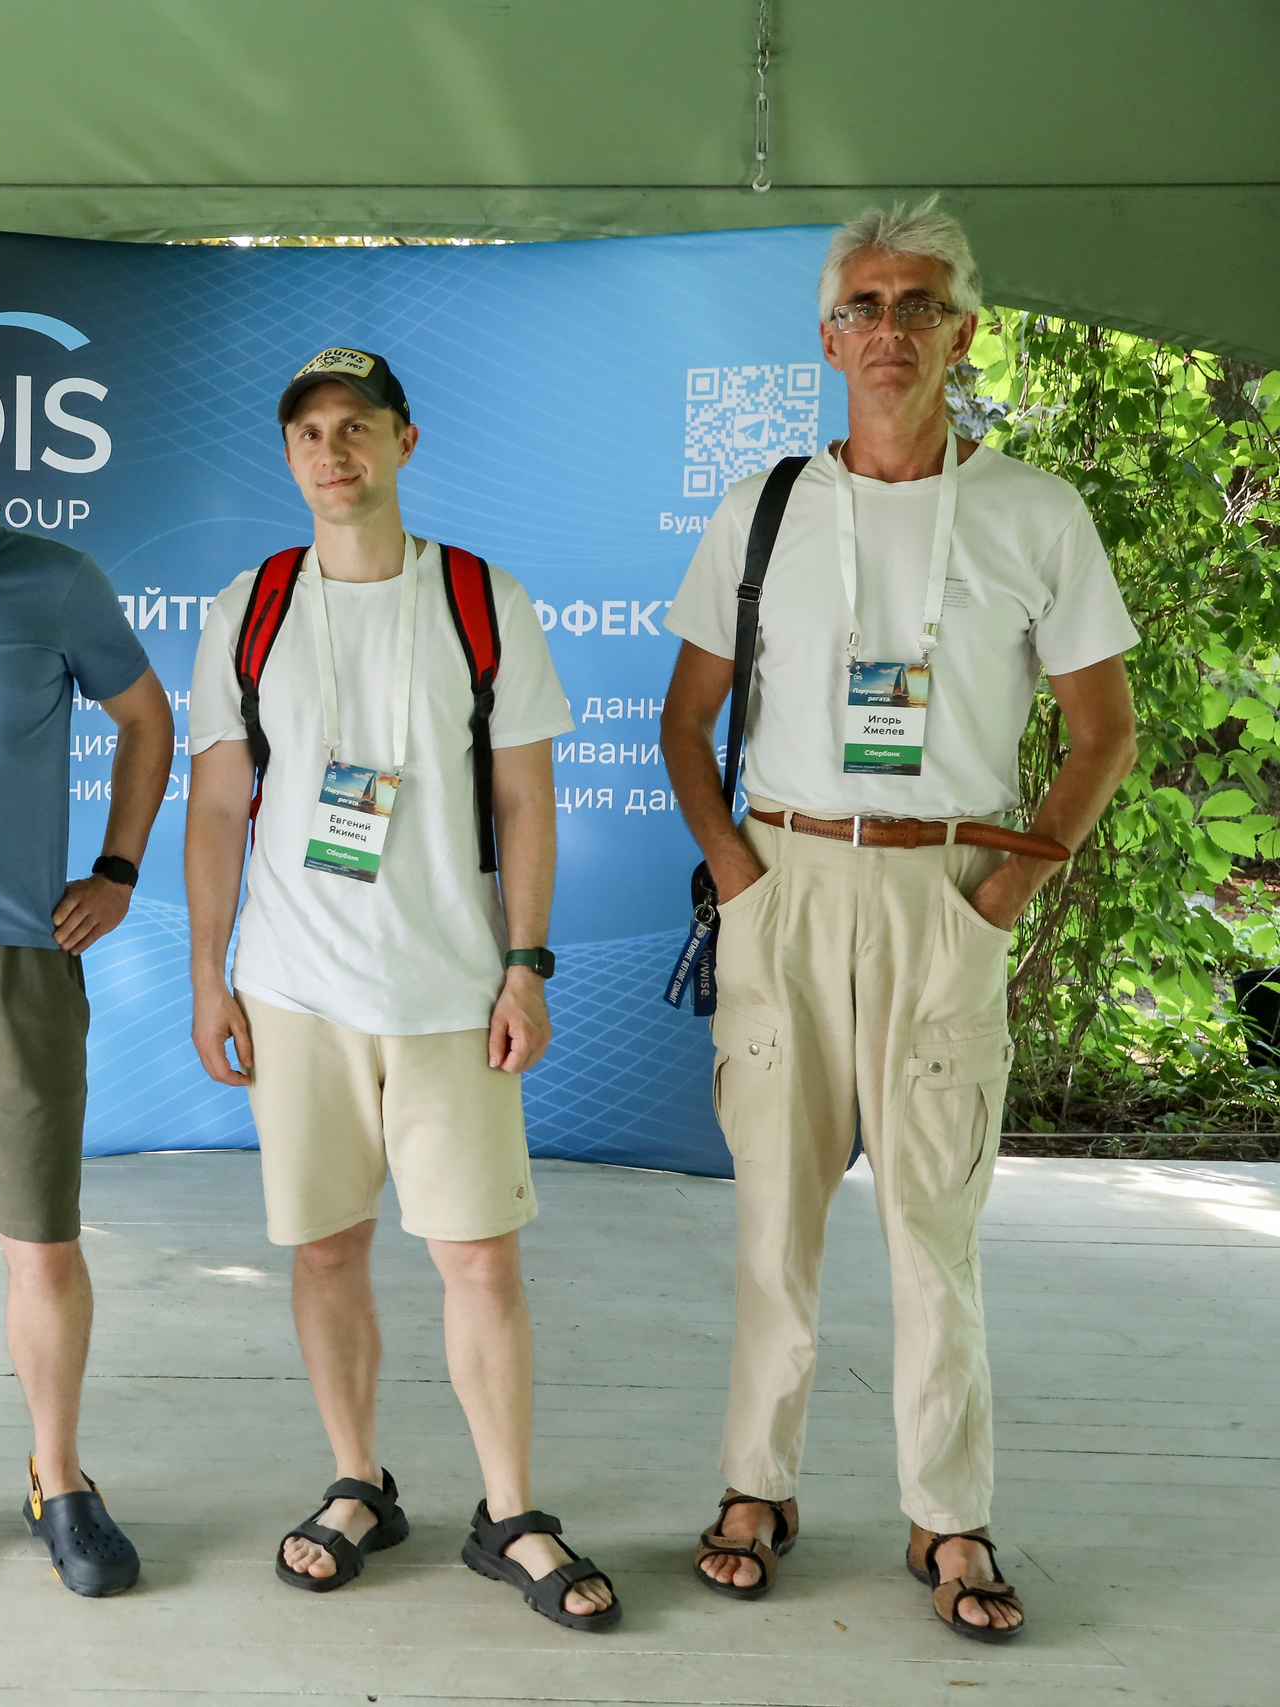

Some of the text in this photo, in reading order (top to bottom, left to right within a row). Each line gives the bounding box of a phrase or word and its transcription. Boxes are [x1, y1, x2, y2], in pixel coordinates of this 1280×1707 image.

[302, 350, 366, 375] PENGUINS
[345, 361, 364, 370] 1967
[532, 599, 673, 637] ФФЕК
[867, 695, 891, 703] регата
[582, 697, 665, 724] данн
[868, 715, 902, 726] Игорь
[863, 725, 905, 736] Хмелев
[552, 742, 665, 765] ивани
[864, 749, 901, 758] Сбербанк
[554, 786, 613, 814] ция
[329, 814, 372, 831] Евгений
[328, 825, 368, 842] Якимец
[325, 848, 360, 862] Сбербанк
[668, 937, 700, 1004] REMOVE BEFORE COMMIT
